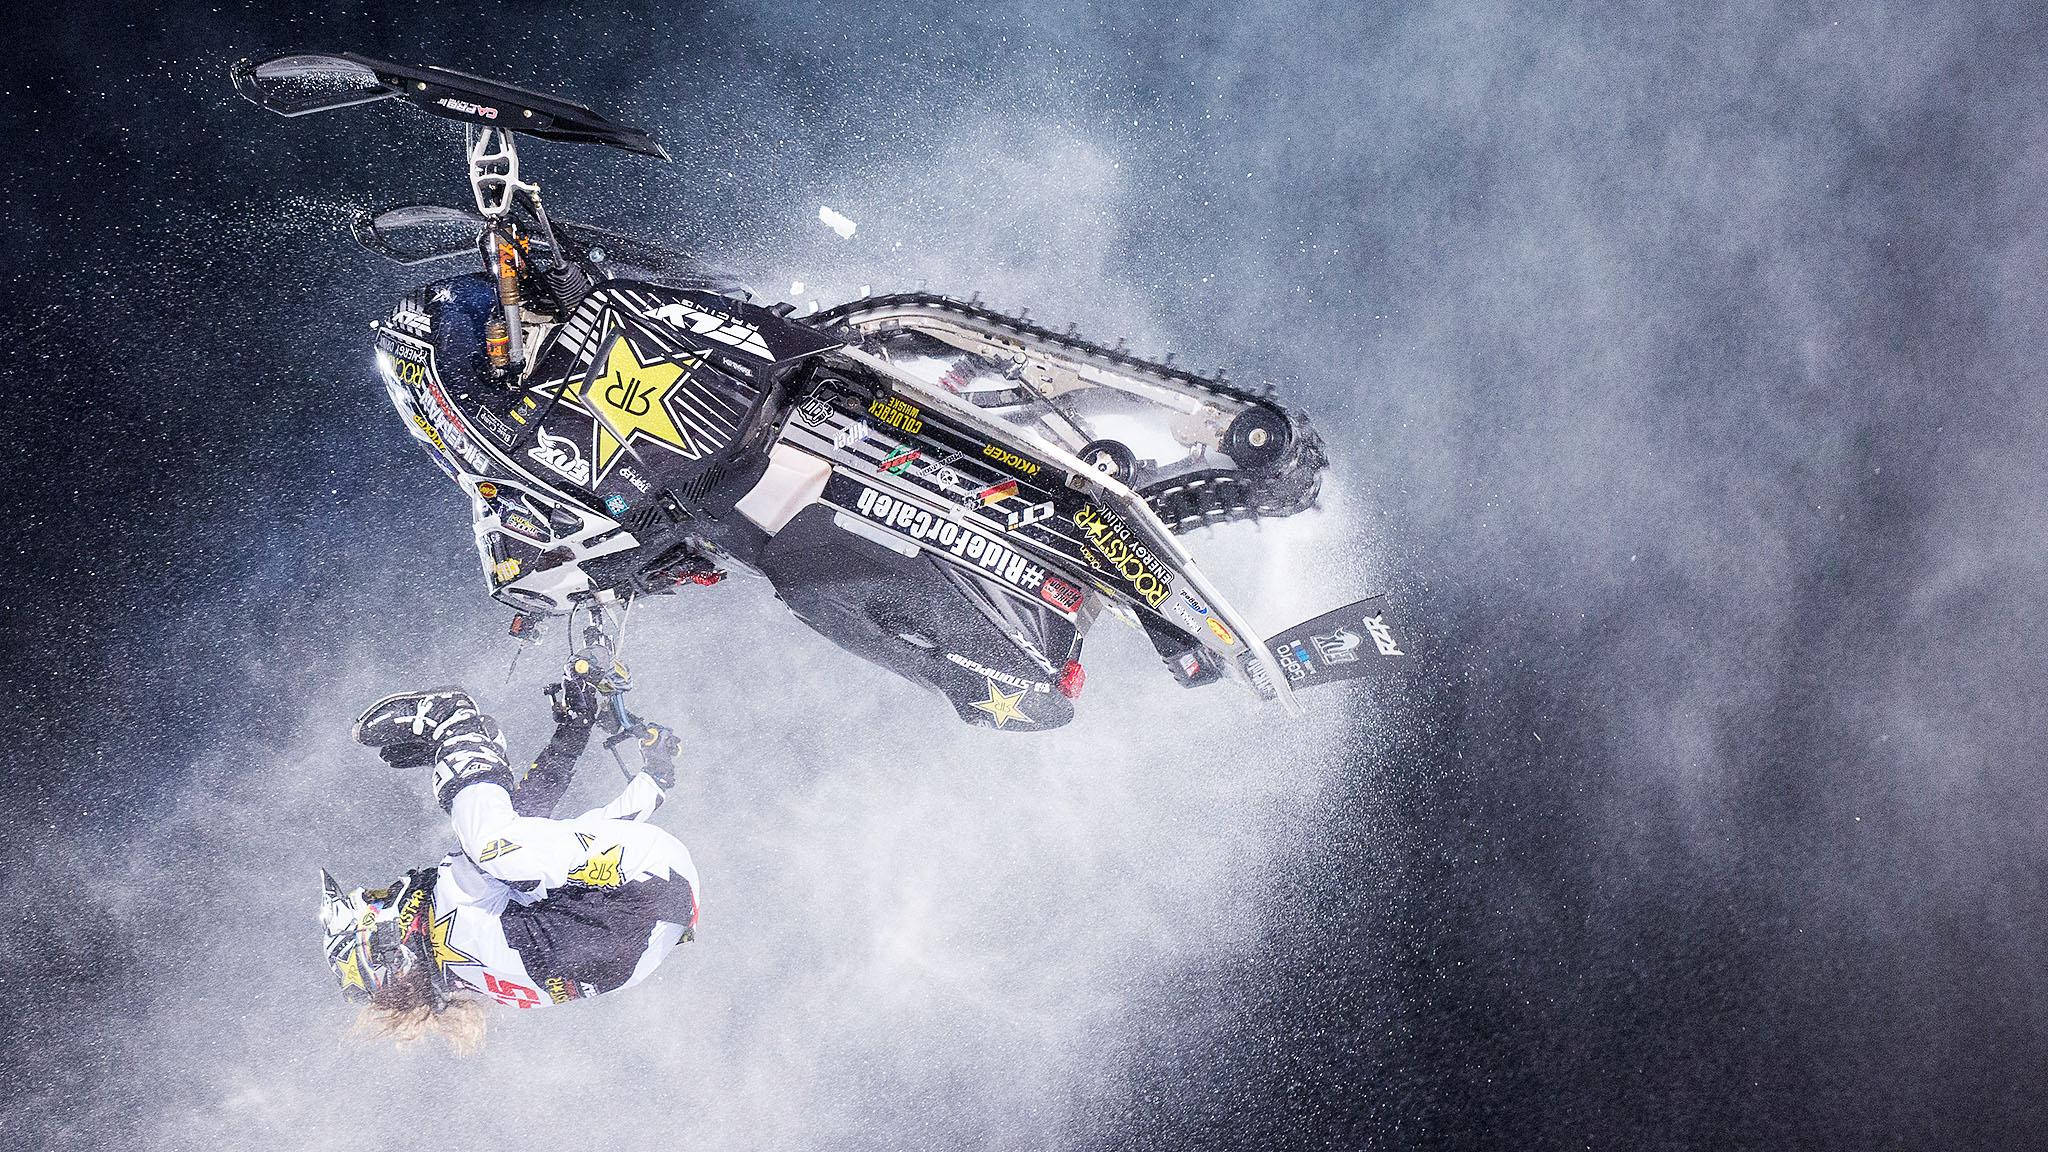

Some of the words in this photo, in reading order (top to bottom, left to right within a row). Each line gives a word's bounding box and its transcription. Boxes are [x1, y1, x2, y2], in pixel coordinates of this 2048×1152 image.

[642, 303, 776, 363] FLY
[672, 297, 759, 332] RACING
[412, 415, 443, 447] KICKER
[866, 399, 923, 434] COLDCOCK
[528, 442, 589, 486] FOX
[982, 443, 1033, 475] KICKER
[856, 487, 1045, 589] #RideForCaleb
[1096, 503, 1131, 541] DRINK
[1074, 504, 1169, 607] ROCKSTAR
[1128, 540, 1172, 585] ENERGY
[946, 652, 1035, 689] STOMPGRIP
[1277, 644, 1305, 681] GoPro
